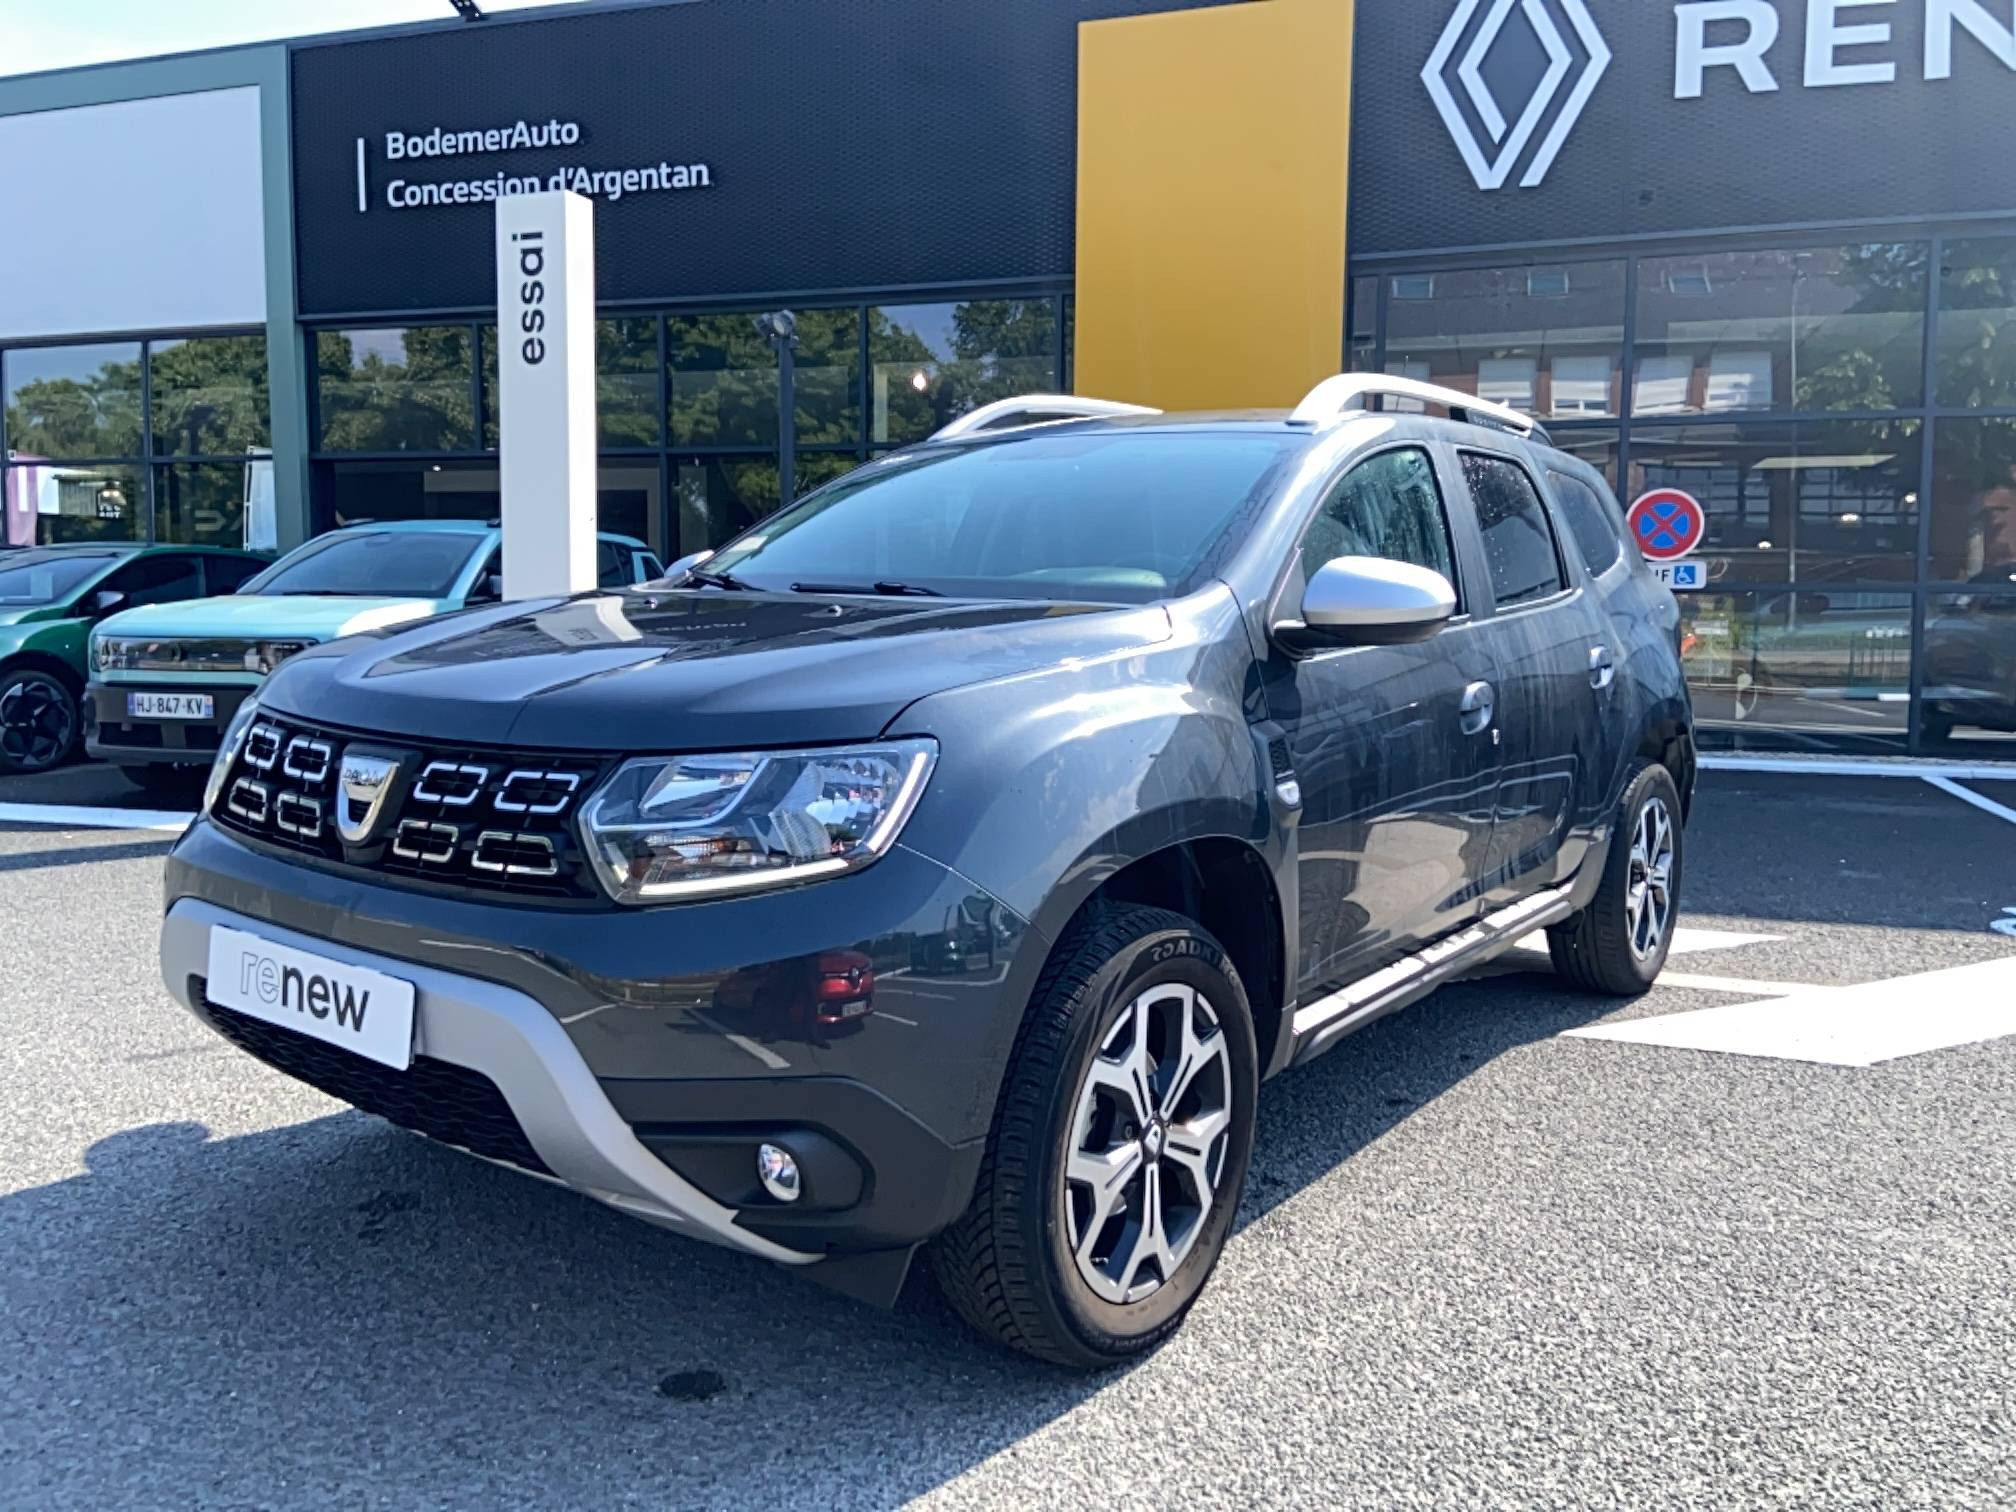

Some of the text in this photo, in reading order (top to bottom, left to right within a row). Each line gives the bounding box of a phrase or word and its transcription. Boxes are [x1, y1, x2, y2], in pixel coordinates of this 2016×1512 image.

[386, 119, 580, 160] BodemerAuto
[386, 161, 710, 208] Concession d'Argentan
[511, 230, 545, 366] essai
[240, 951, 371, 1033] renew
